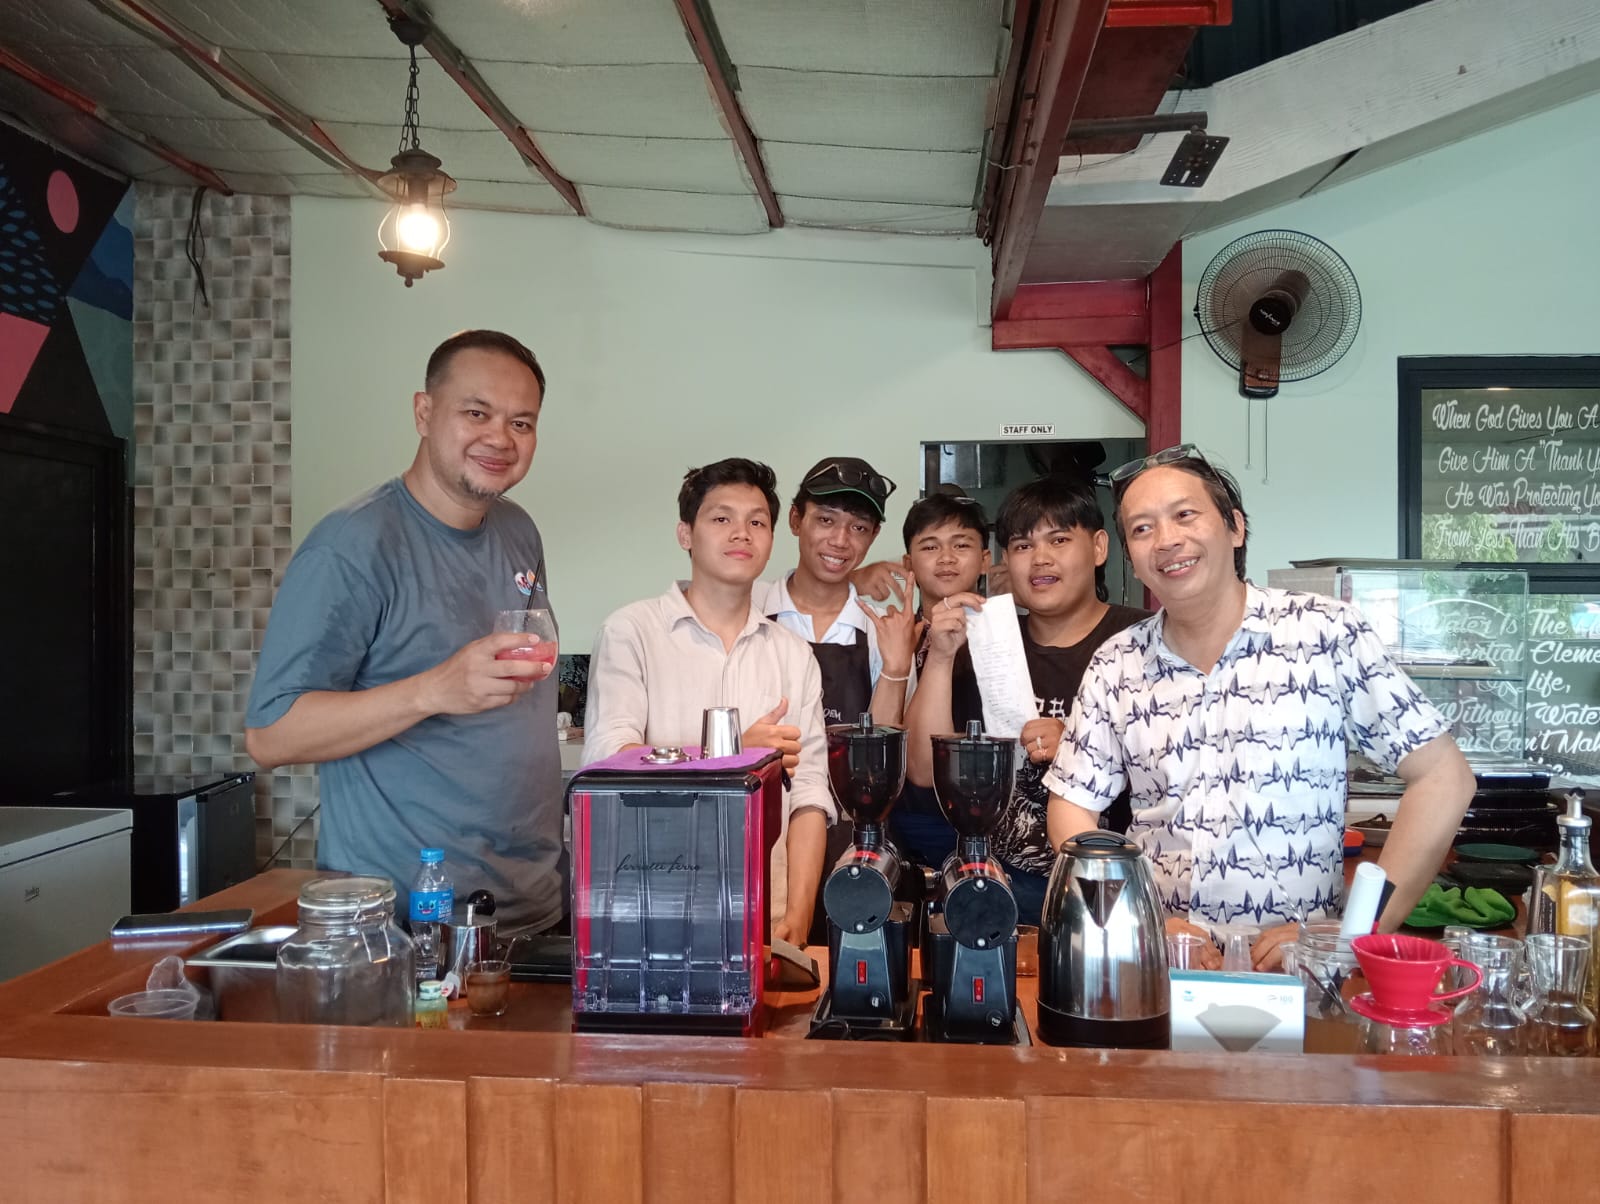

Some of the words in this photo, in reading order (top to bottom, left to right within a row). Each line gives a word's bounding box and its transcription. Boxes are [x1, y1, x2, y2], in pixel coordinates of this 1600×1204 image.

[1003, 426, 1028, 434] STAFF
[1030, 425, 1052, 433] ONLY
[1432, 400, 1471, 430] When
[1475, 404, 1504, 431] God
[1507, 404, 1542, 431] Gives
[1546, 404, 1574, 436] You
[1577, 403, 1599, 430] A
[1438, 446, 1469, 473] Give
[1473, 446, 1510, 473] Him
[1514, 446, 1536, 472] A
[1586, 447, 1600, 478] Y
[1445, 482, 1475, 509] He
[1479, 483, 1510, 507] Was
[1513, 477, 1582, 513] Protecting
[1434, 519, 1471, 550] From
[1474, 523, 1505, 550] Less
[1509, 520, 1544, 549] Than
[1548, 522, 1580, 551] His
[1499, 612, 1518, 635] Is
[1528, 608, 1568, 636] The
[1526, 669, 1571, 697] Life,
[1535, 703, 1600, 725] Wate
